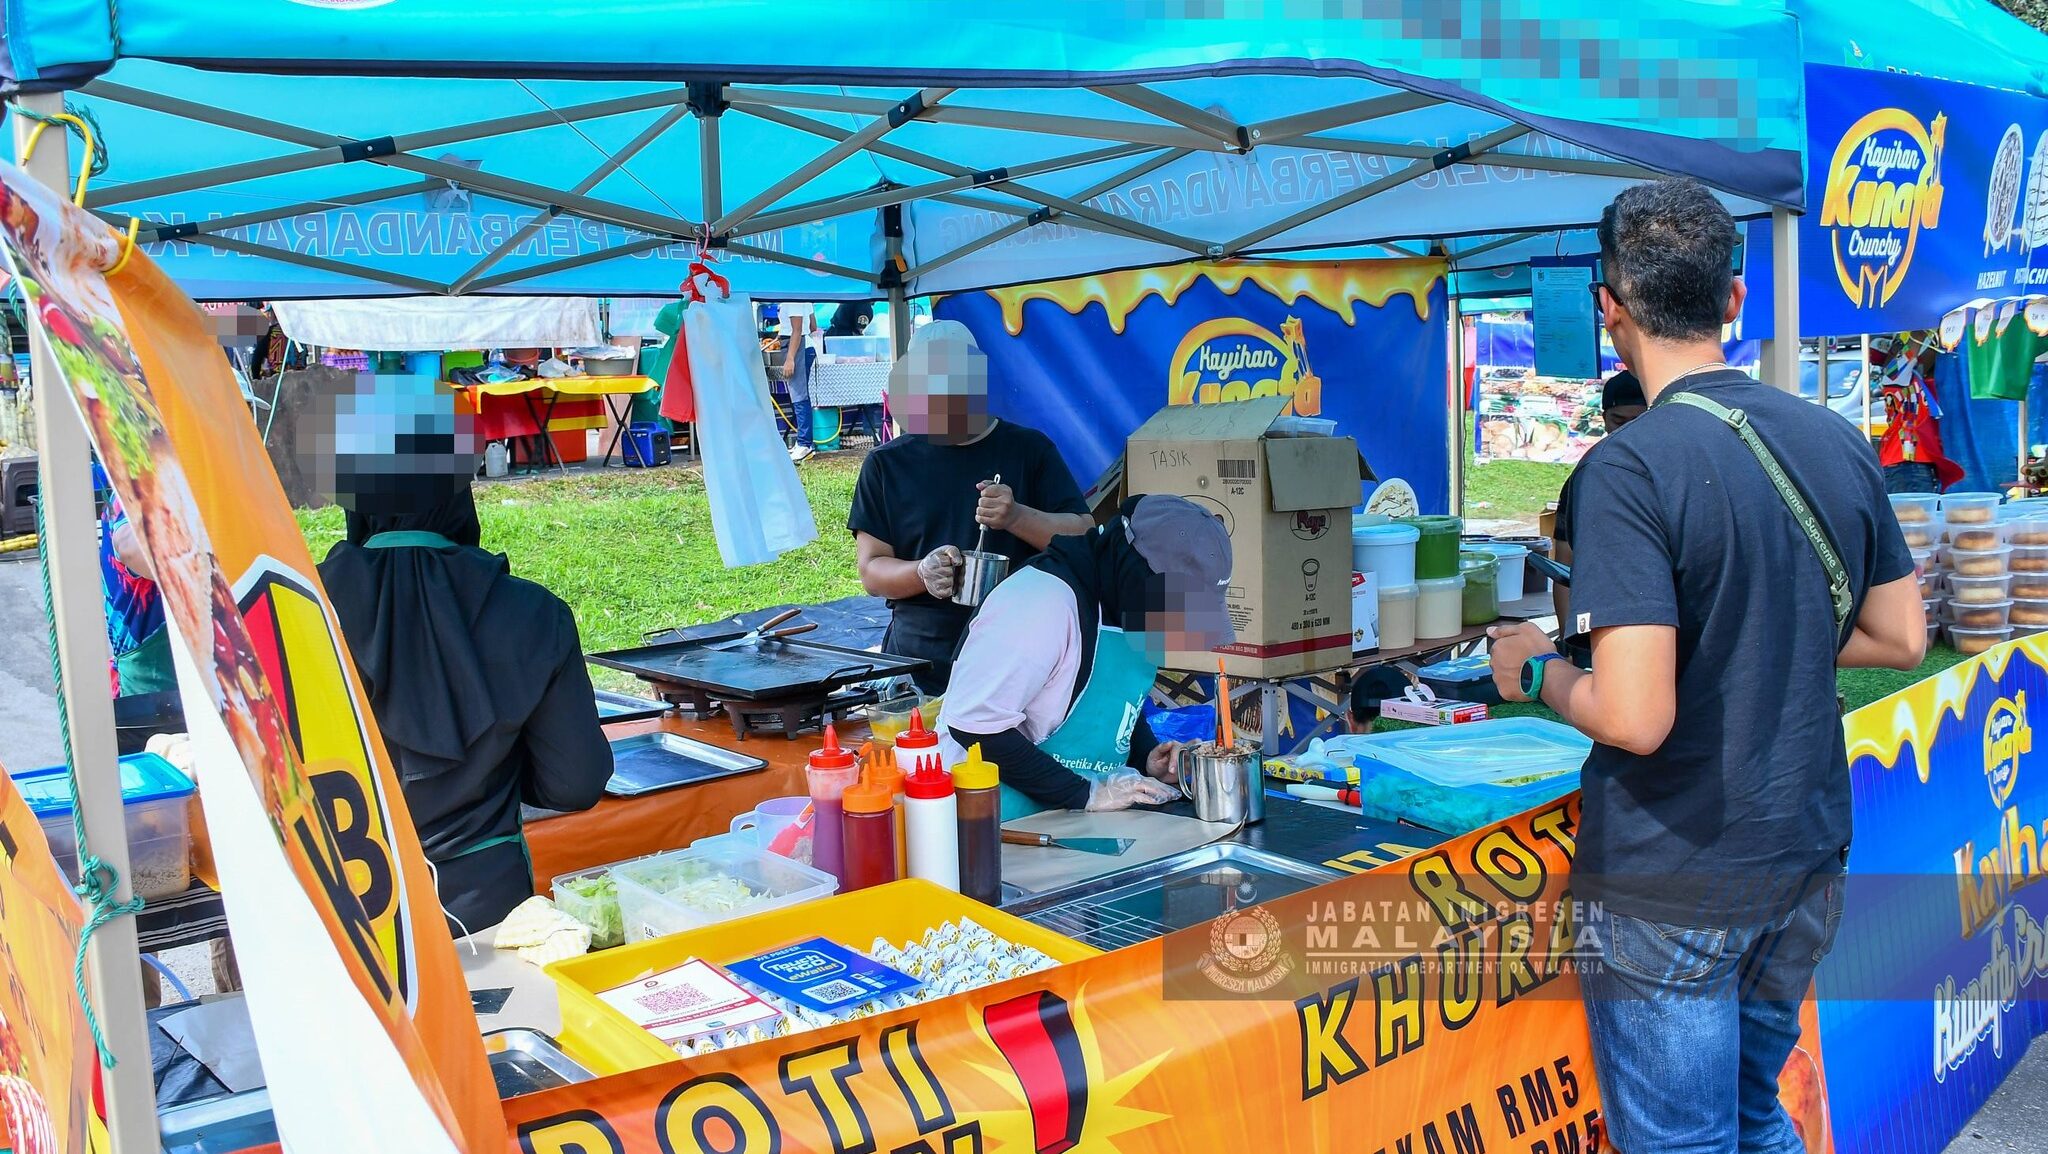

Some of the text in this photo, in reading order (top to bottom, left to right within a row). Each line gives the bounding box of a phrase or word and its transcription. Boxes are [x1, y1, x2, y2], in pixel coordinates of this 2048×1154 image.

[1860, 136, 1920, 180] Kayihan
[1820, 165, 1945, 231] Kunafa
[1848, 229, 1902, 267] Crunchy
[1199, 344, 1278, 381] Kayihan
[1149, 450, 1192, 471] TASIK
[1768, 461, 1805, 514] Supreme
[1804, 516, 1836, 569] Supreme
[754, 946, 800, 963] WE PREFER
[767, 953, 820, 972] Touch
[788, 961, 840, 982] eWallet
[1933, 924, 2017, 1084] Kunafa
[1495, 1054, 1580, 1140] RM5
